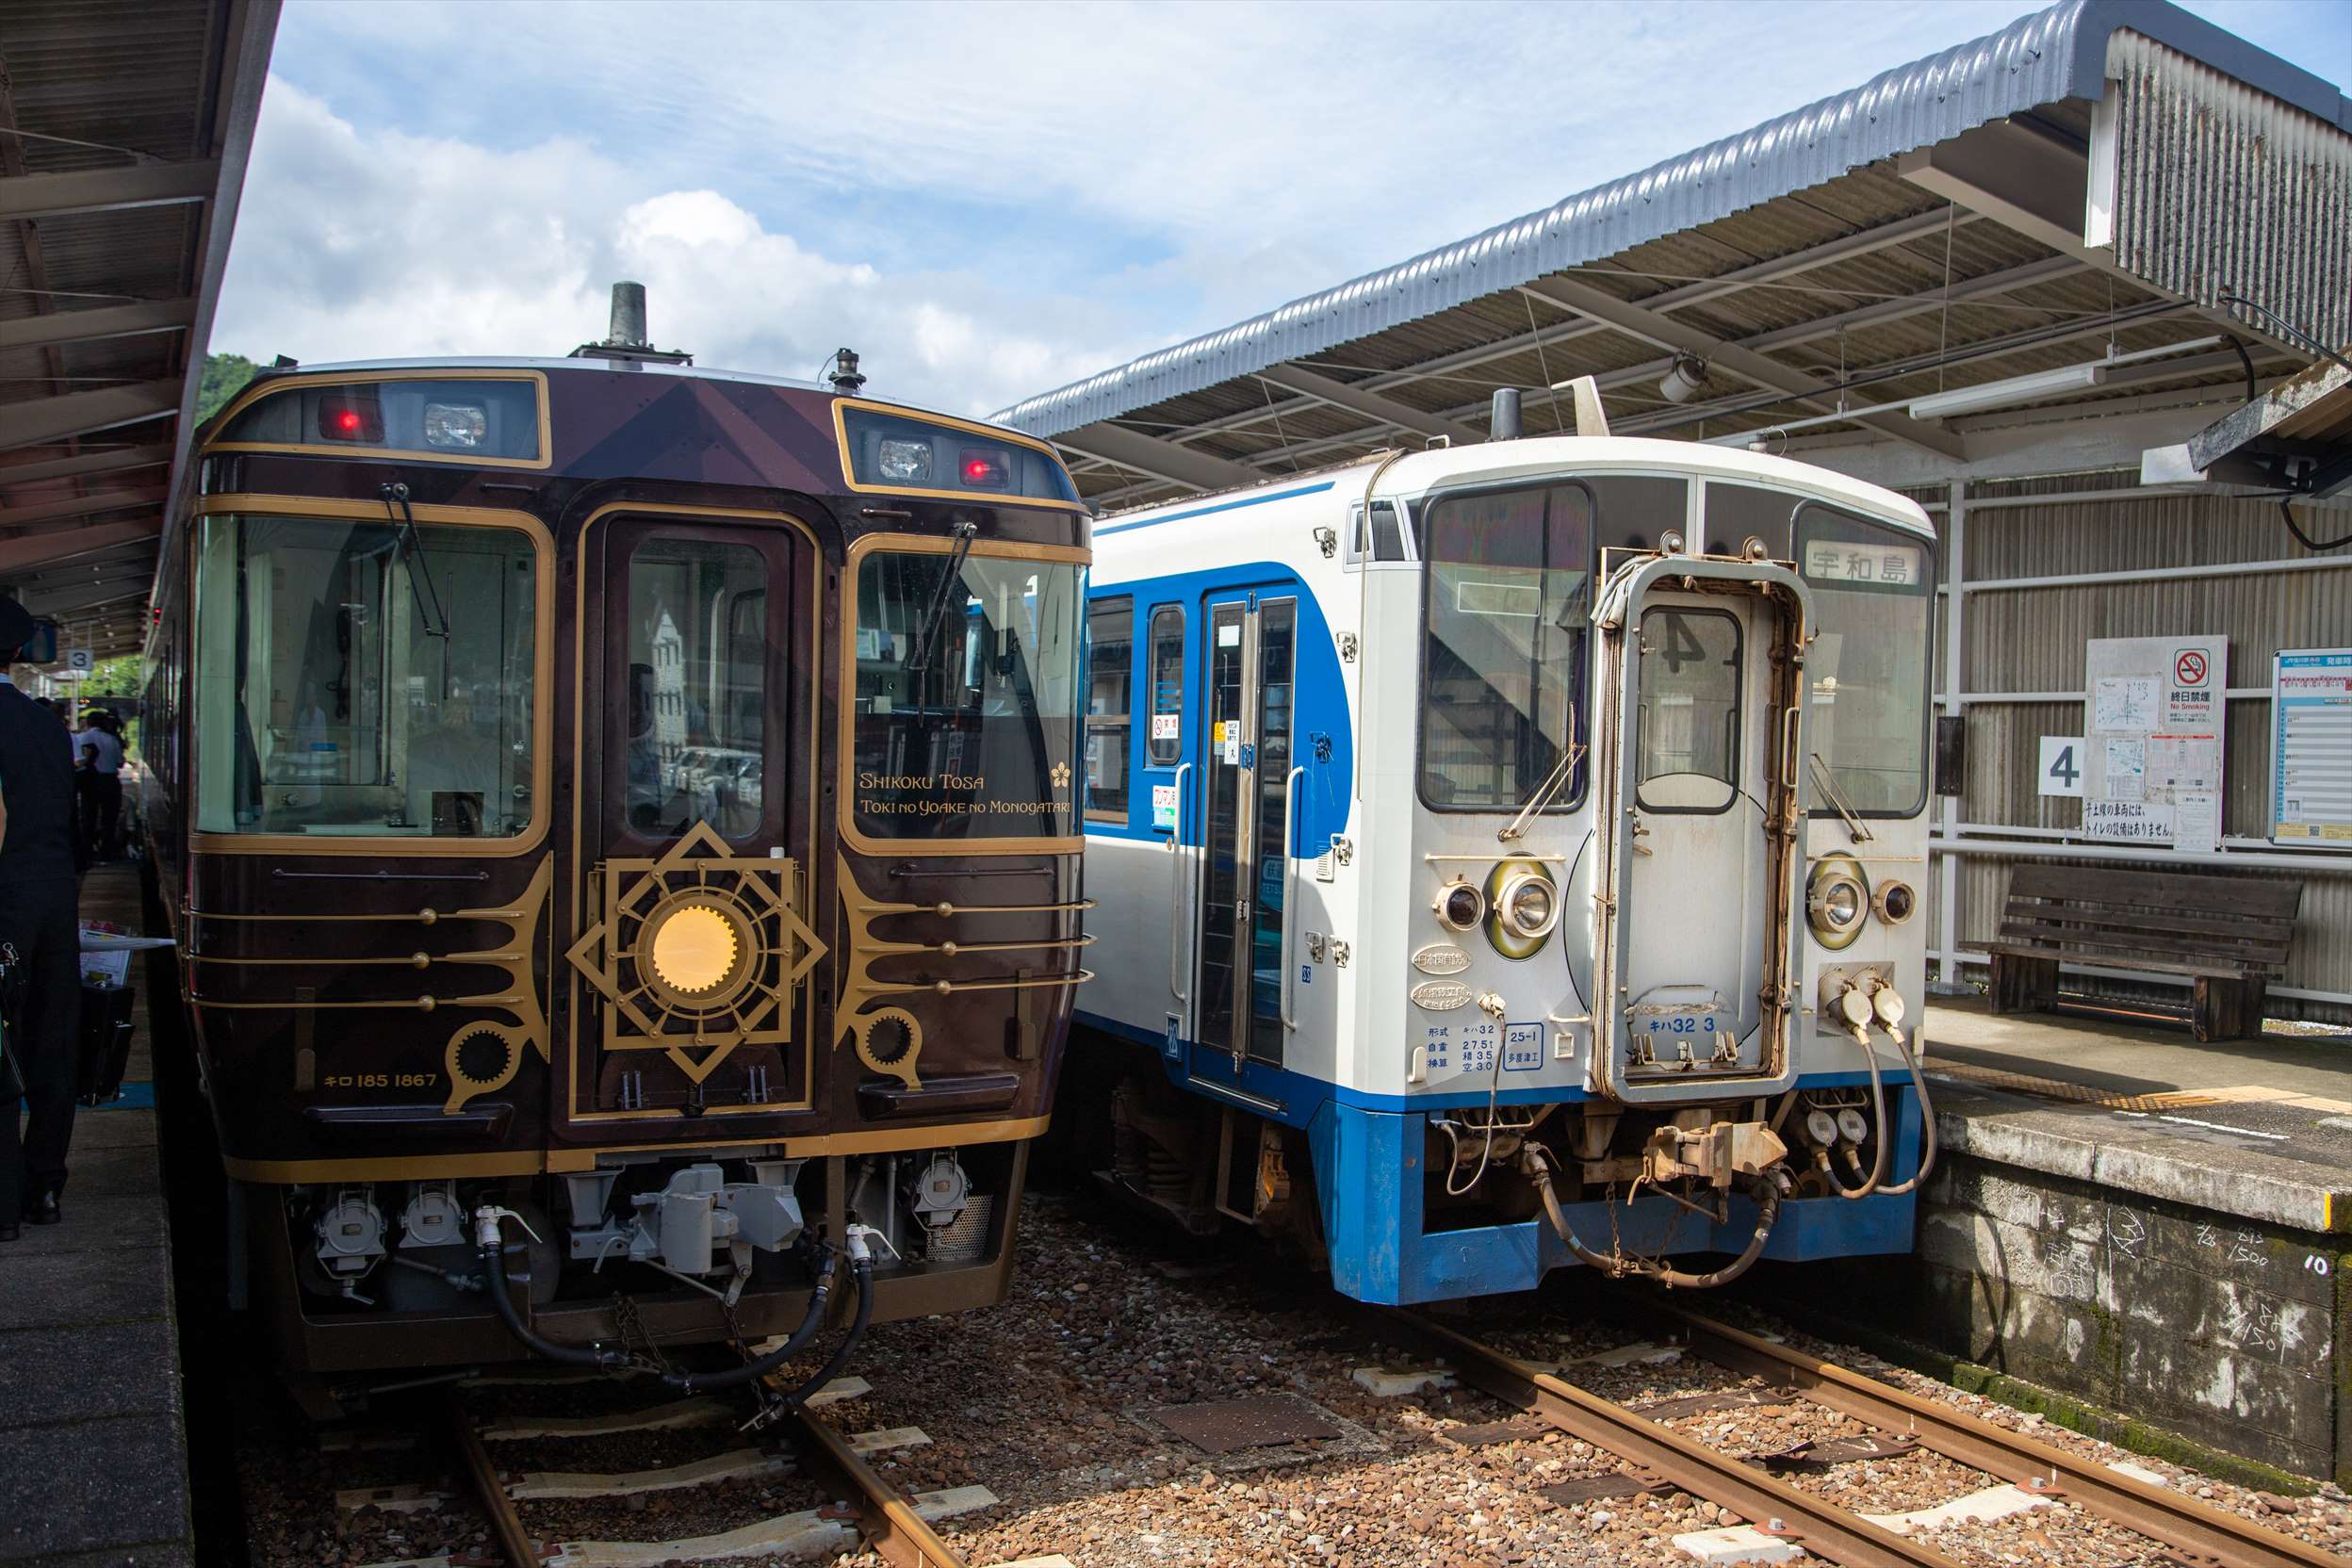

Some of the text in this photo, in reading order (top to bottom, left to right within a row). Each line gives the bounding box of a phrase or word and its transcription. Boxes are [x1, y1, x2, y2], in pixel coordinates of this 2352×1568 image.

[1812, 549, 1907, 582] 宇和島
[73, 651, 88, 667] 3
[2170, 691, 2211, 702] 終日禁煙
[2181, 703, 2210, 711] Smoking
[2050, 745, 2080, 788] 4
[2085, 821, 2173, 838] トイレの設備はありません。
[1302, 967, 1311, 982] SS
[1429, 1027, 1449, 1037] 形式
[1704, 1017, 1715, 1033] 3
[323, 1074, 437, 1087] キロ 185 1867
[2304, 1254, 2328, 1275] 10
